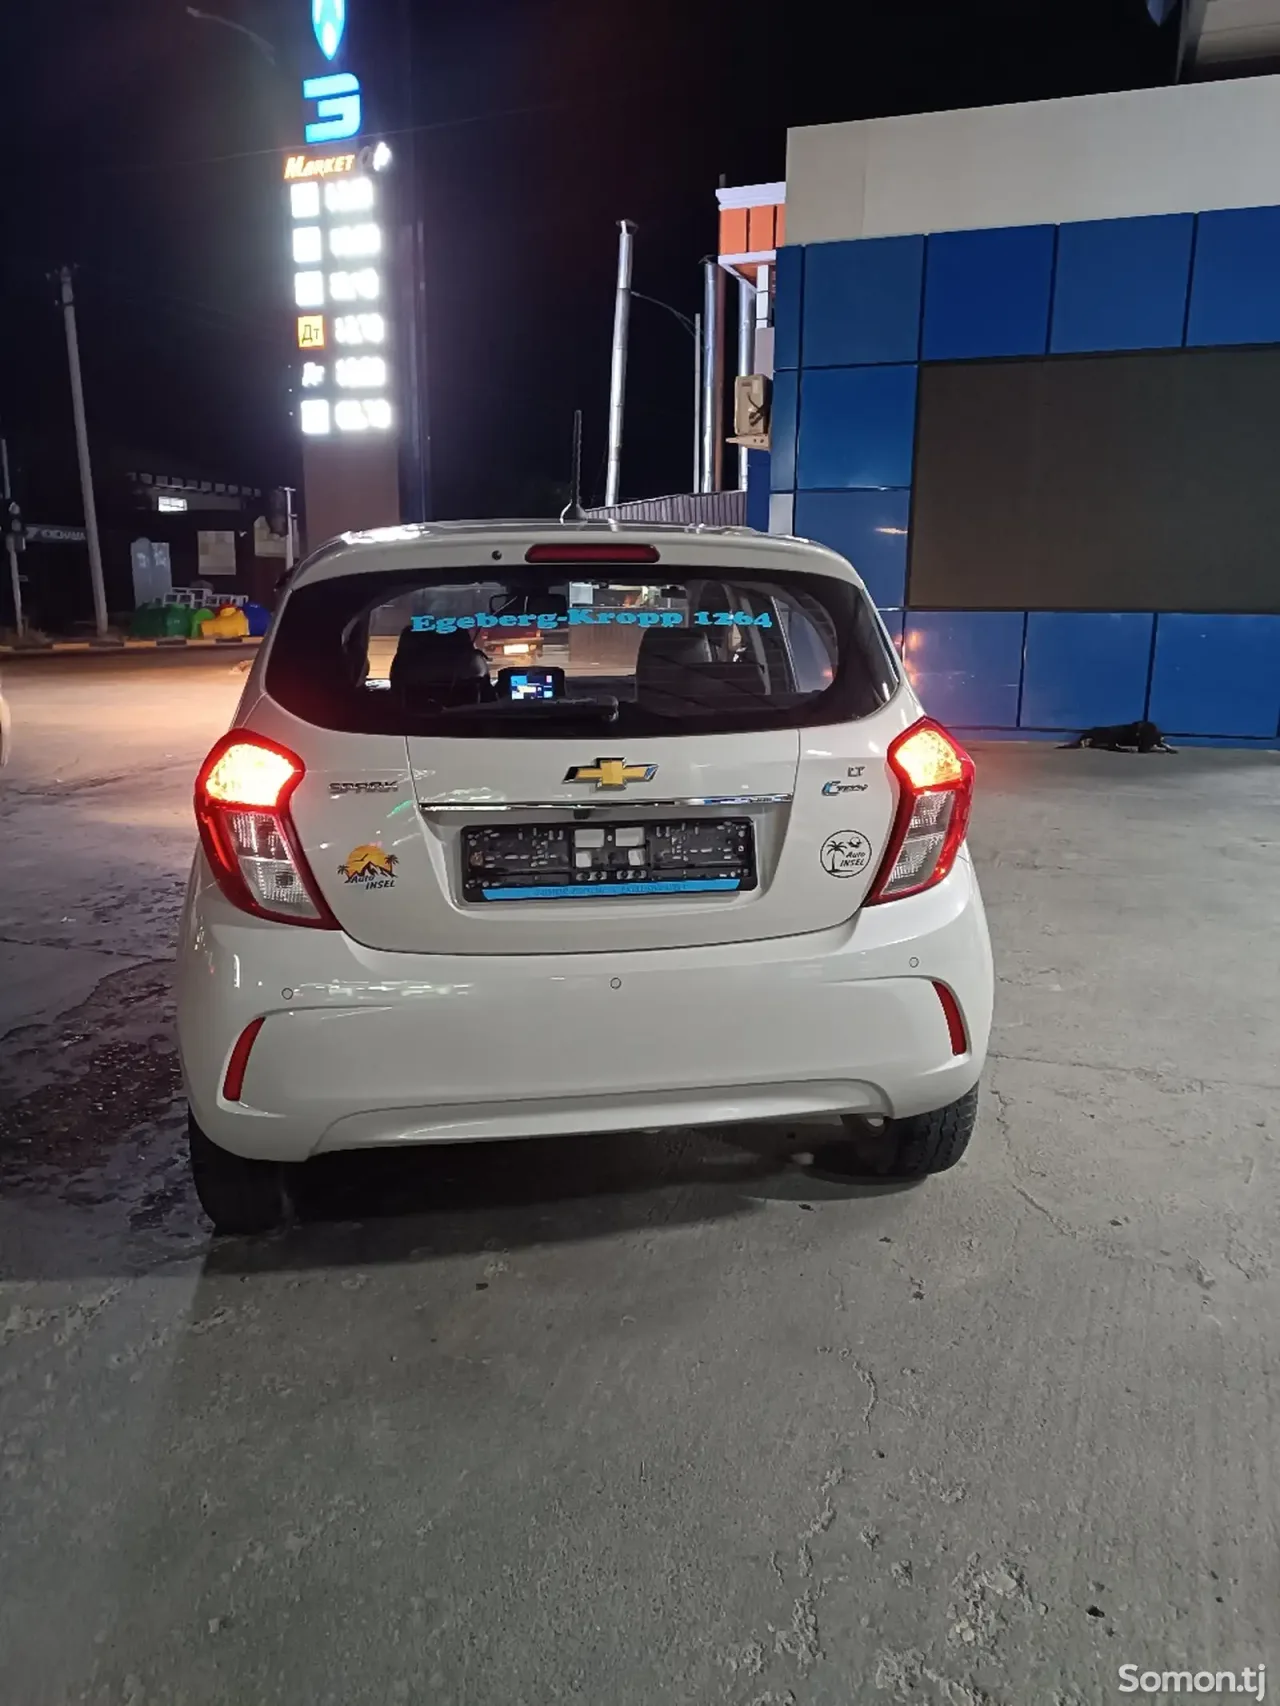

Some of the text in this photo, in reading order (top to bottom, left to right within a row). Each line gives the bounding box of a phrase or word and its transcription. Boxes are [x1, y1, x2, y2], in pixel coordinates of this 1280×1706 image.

[411, 608, 773, 634] Egeberg-Kropp 1264
[329, 781, 399, 795] SPARK
[839, 858, 865, 867] INSEL
[365, 880, 396, 890] INSEL
